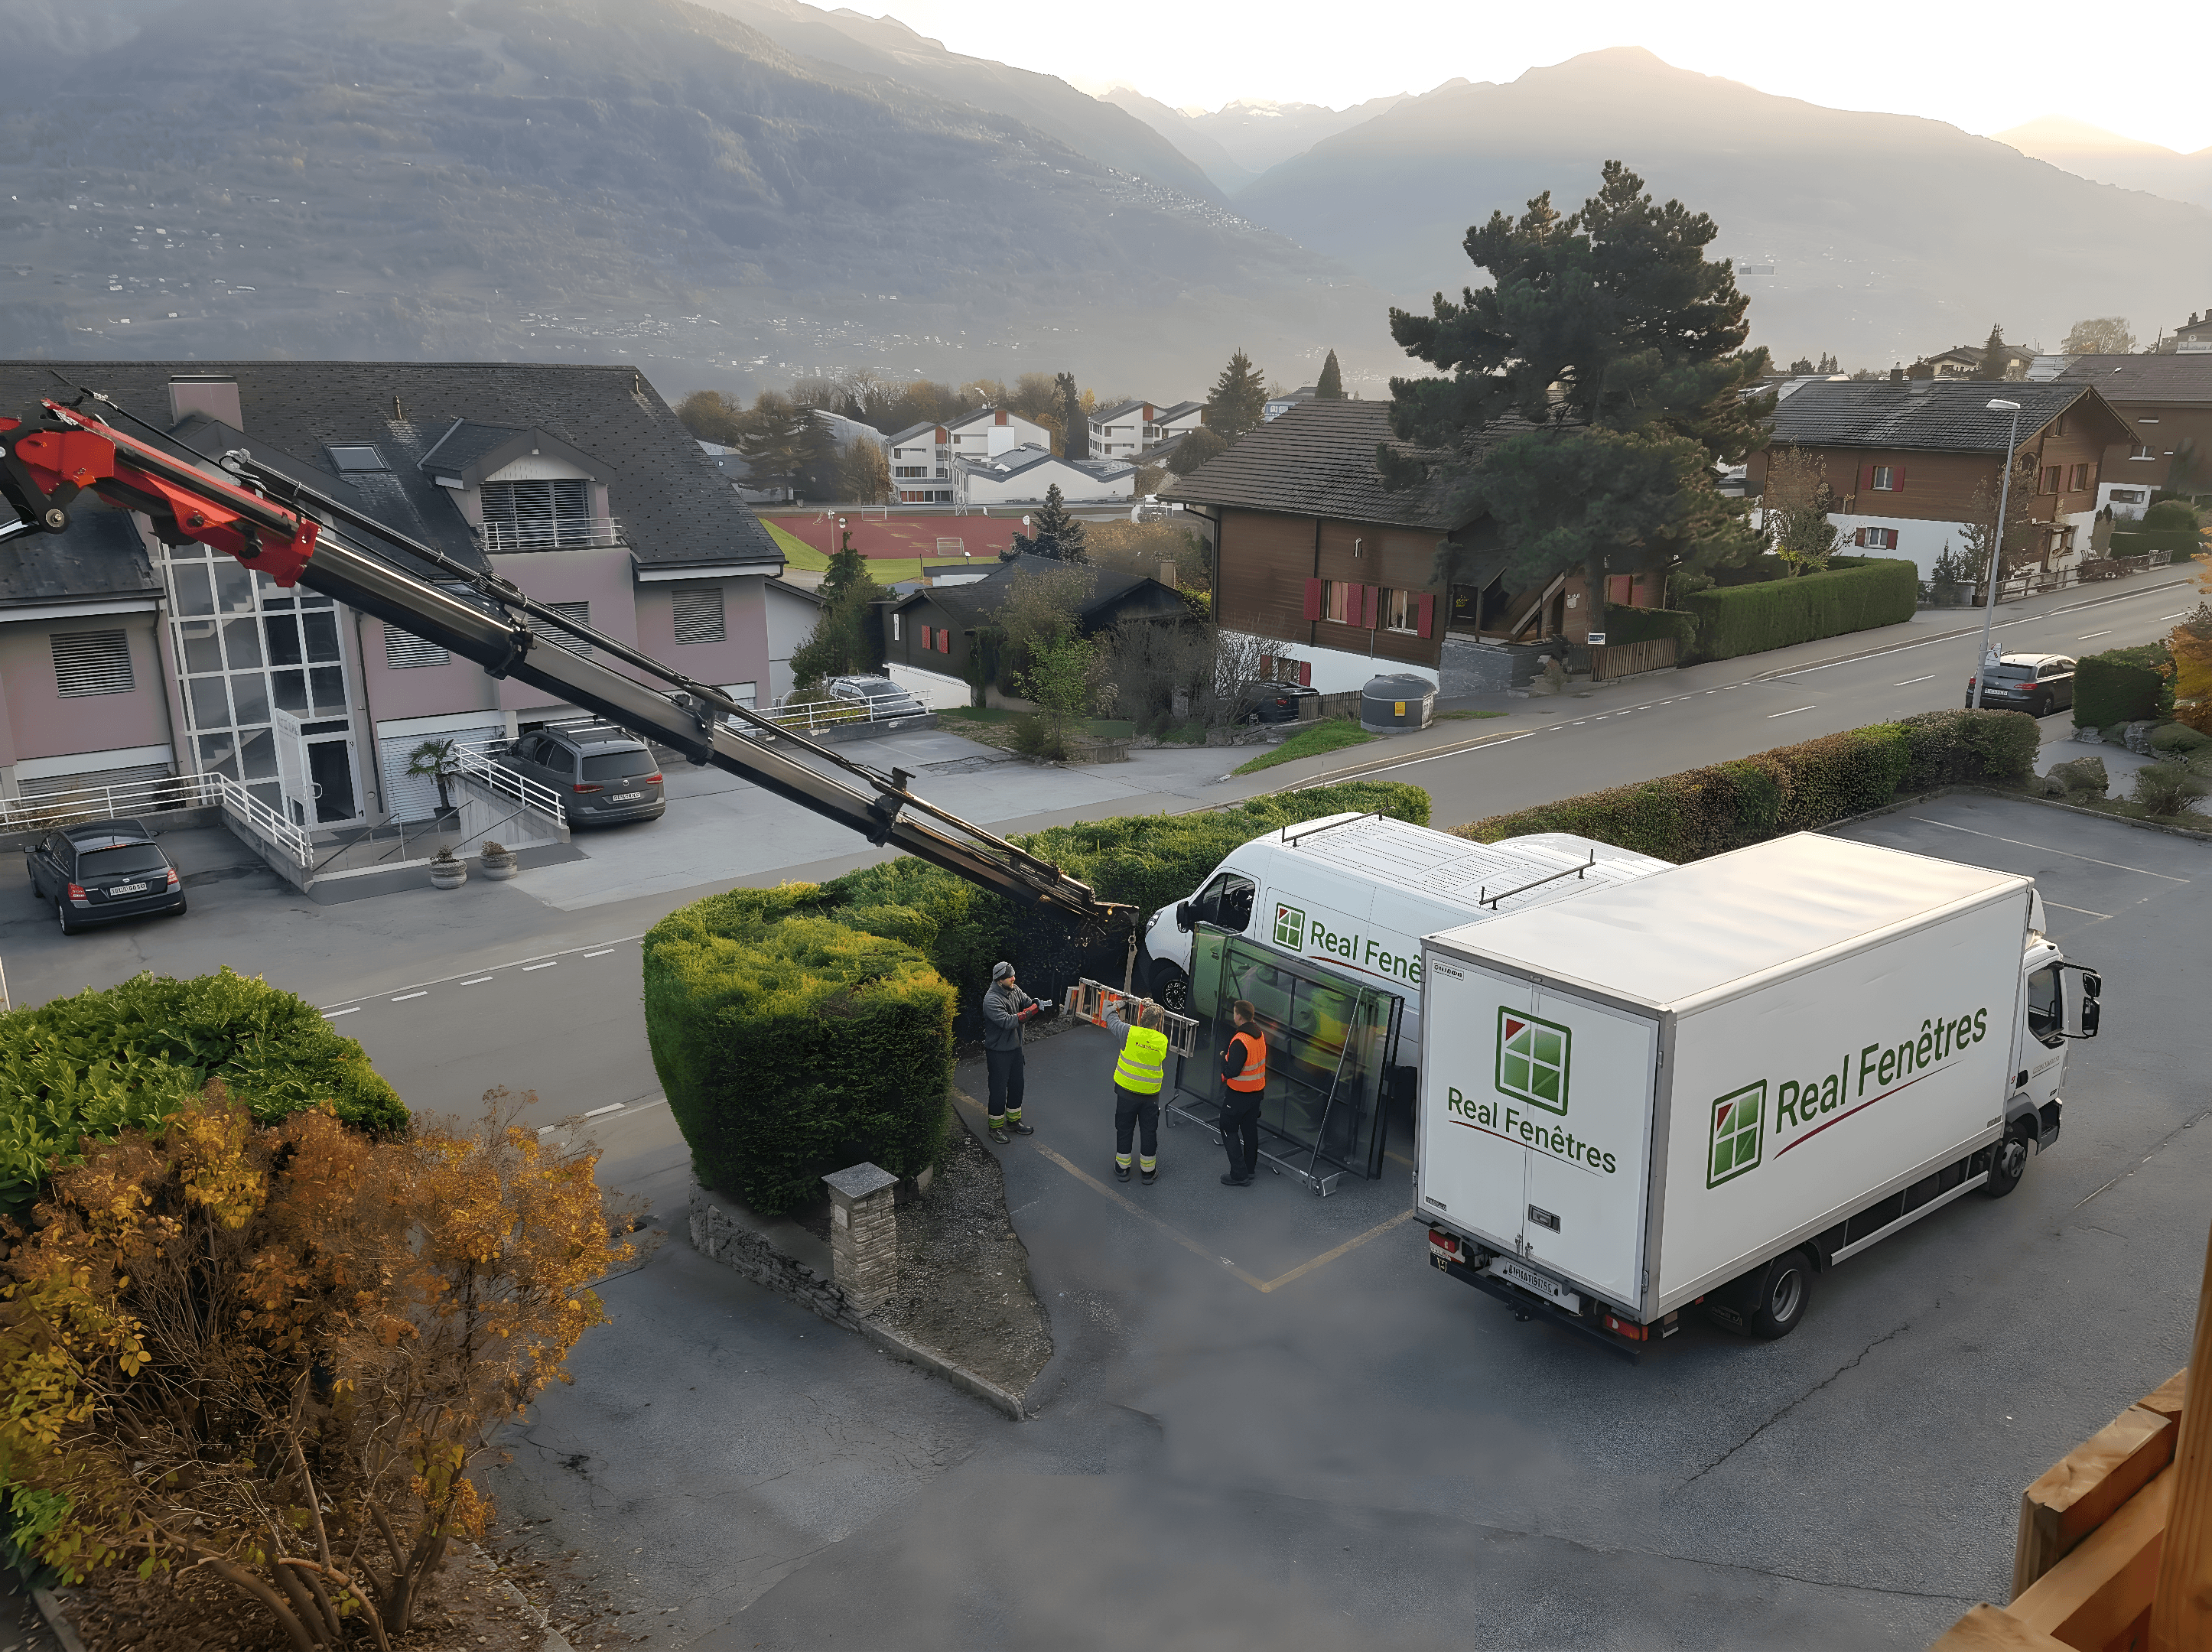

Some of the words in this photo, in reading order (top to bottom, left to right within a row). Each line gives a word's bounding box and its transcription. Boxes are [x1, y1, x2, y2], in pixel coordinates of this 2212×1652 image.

[1310, 920, 1359, 961] Real
[1775, 1054, 1850, 1134] Real
[1858, 1007, 1988, 1097] Fenêtres
[1448, 1086, 1498, 1129] Real
[1505, 1107, 1617, 1174] Fenêtres
